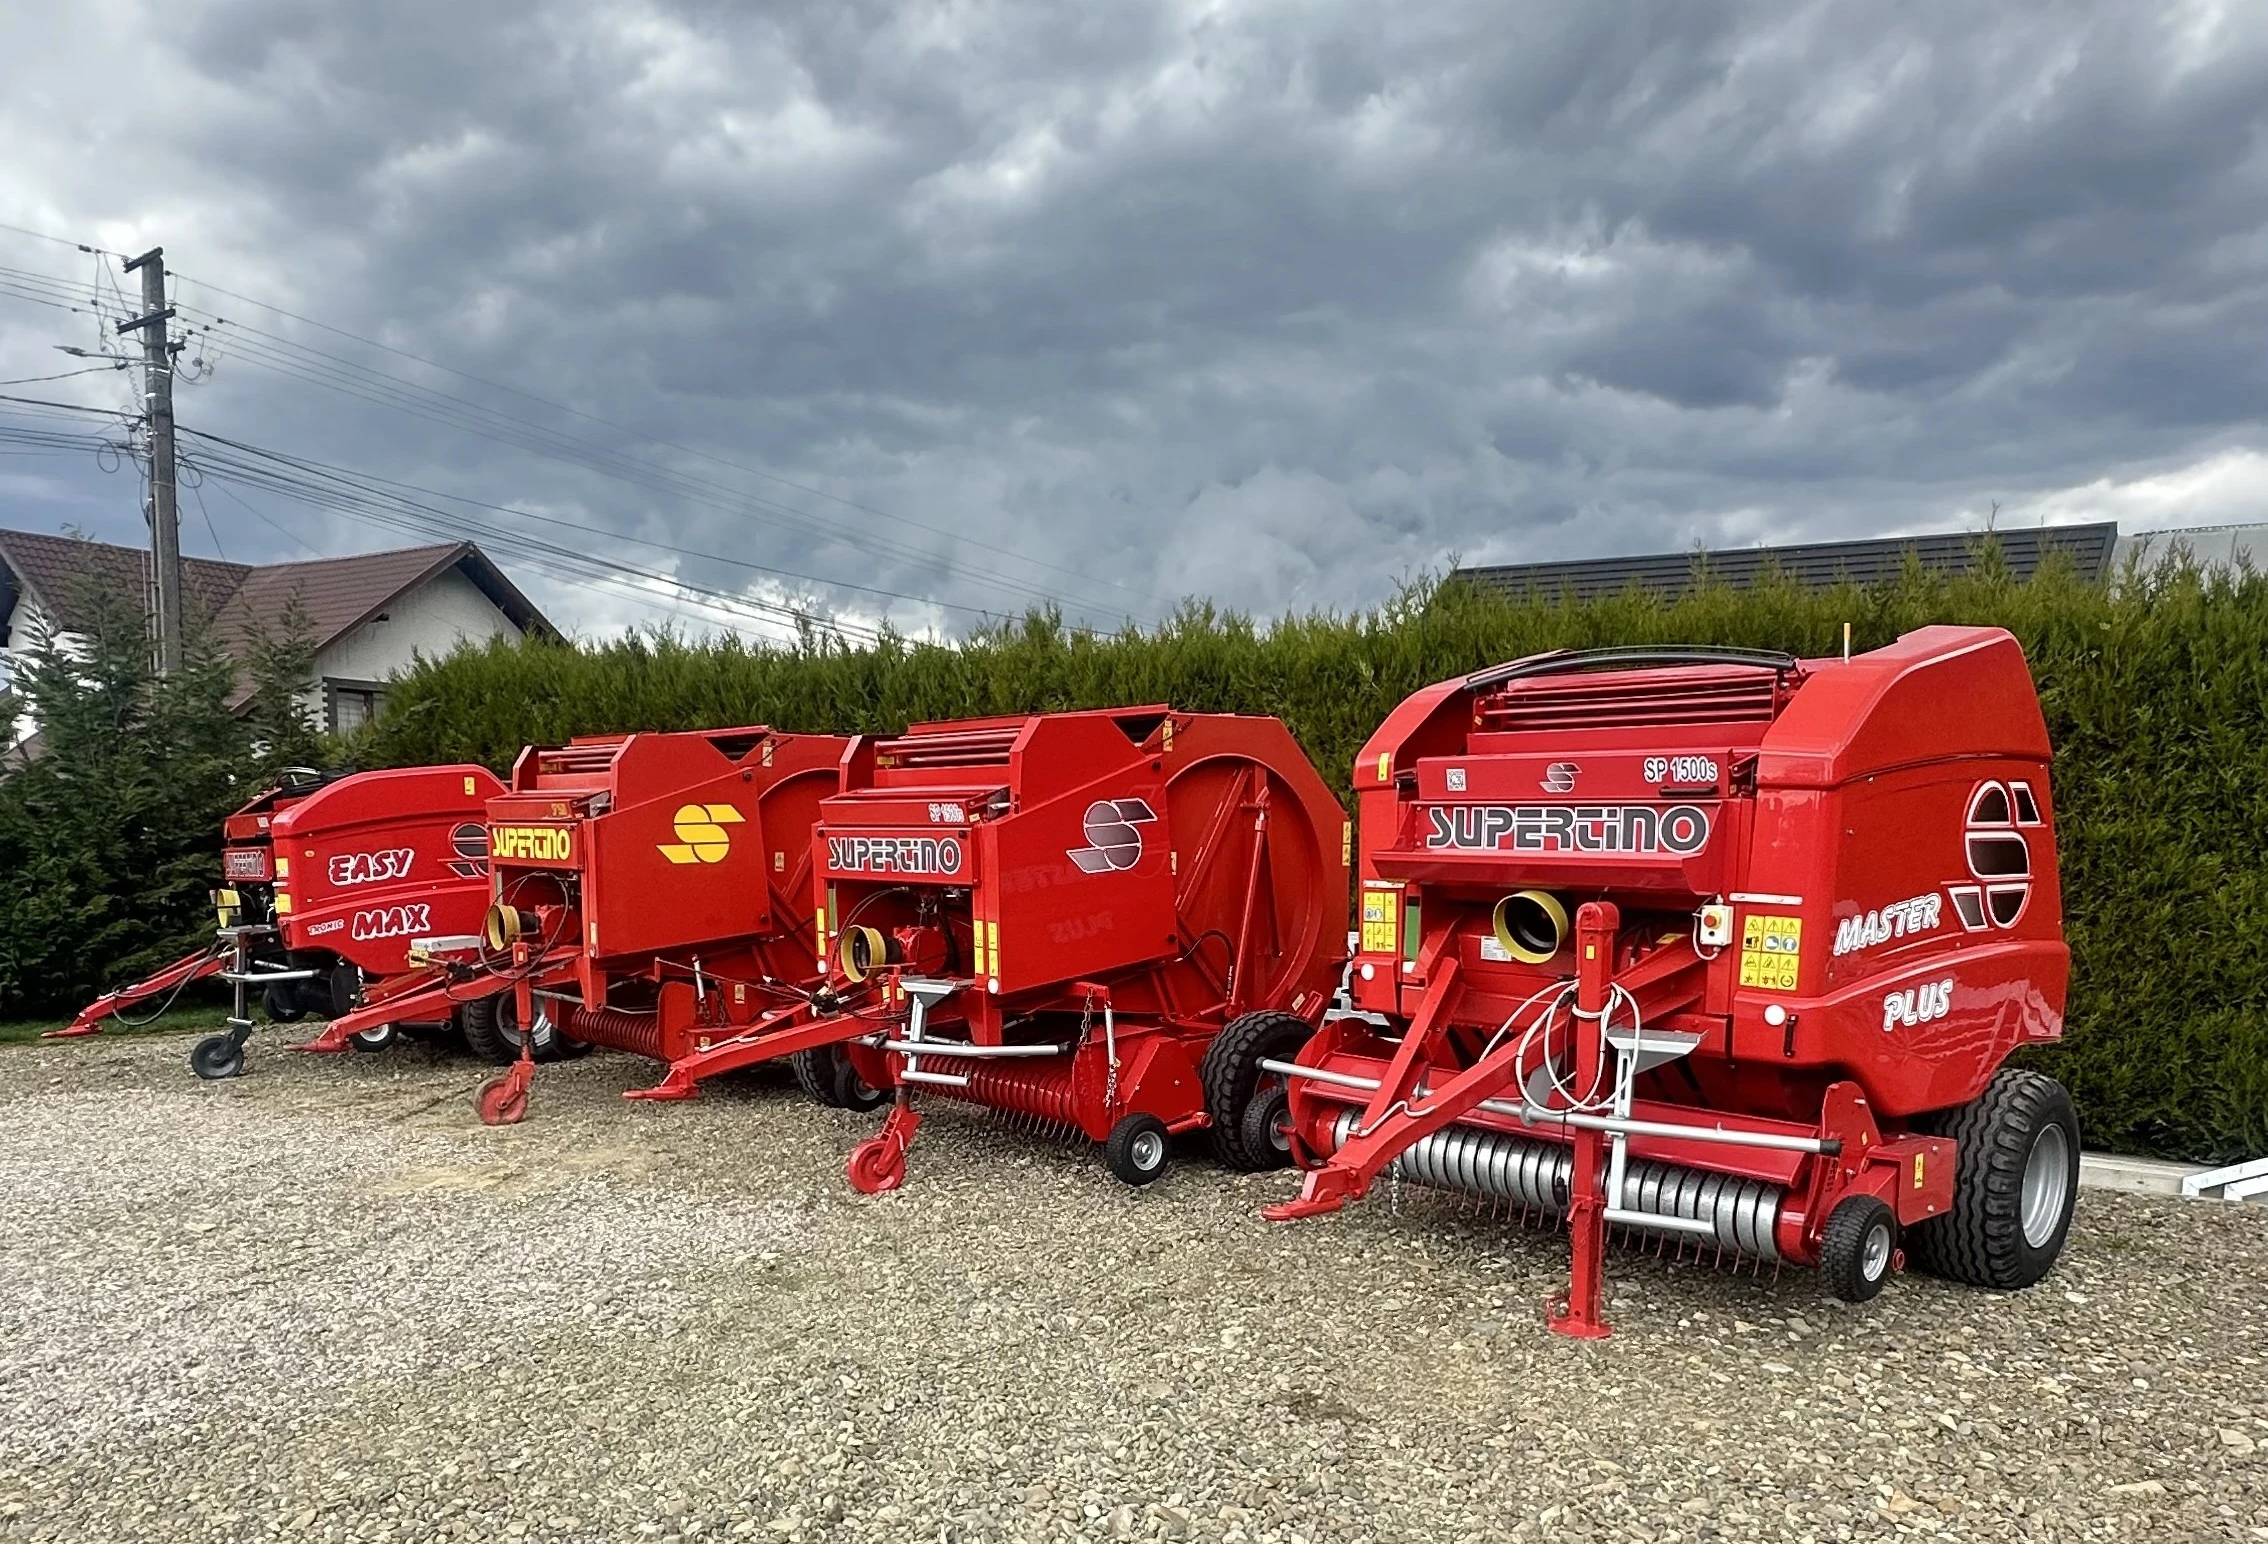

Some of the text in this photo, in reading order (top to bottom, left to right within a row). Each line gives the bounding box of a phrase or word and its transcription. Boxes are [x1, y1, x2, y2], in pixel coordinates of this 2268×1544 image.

[1643, 755, 1718, 782] SP 1500s
[492, 827, 571, 860] SUPERTINO
[1427, 805, 1710, 855] SUPERTINO
[328, 848, 415, 886] EASY
[828, 837, 962, 875] SUPERTINO
[352, 903, 431, 941] MAX
[1833, 892, 1942, 956] MASTER
[1883, 978, 1954, 1032] PLUS
